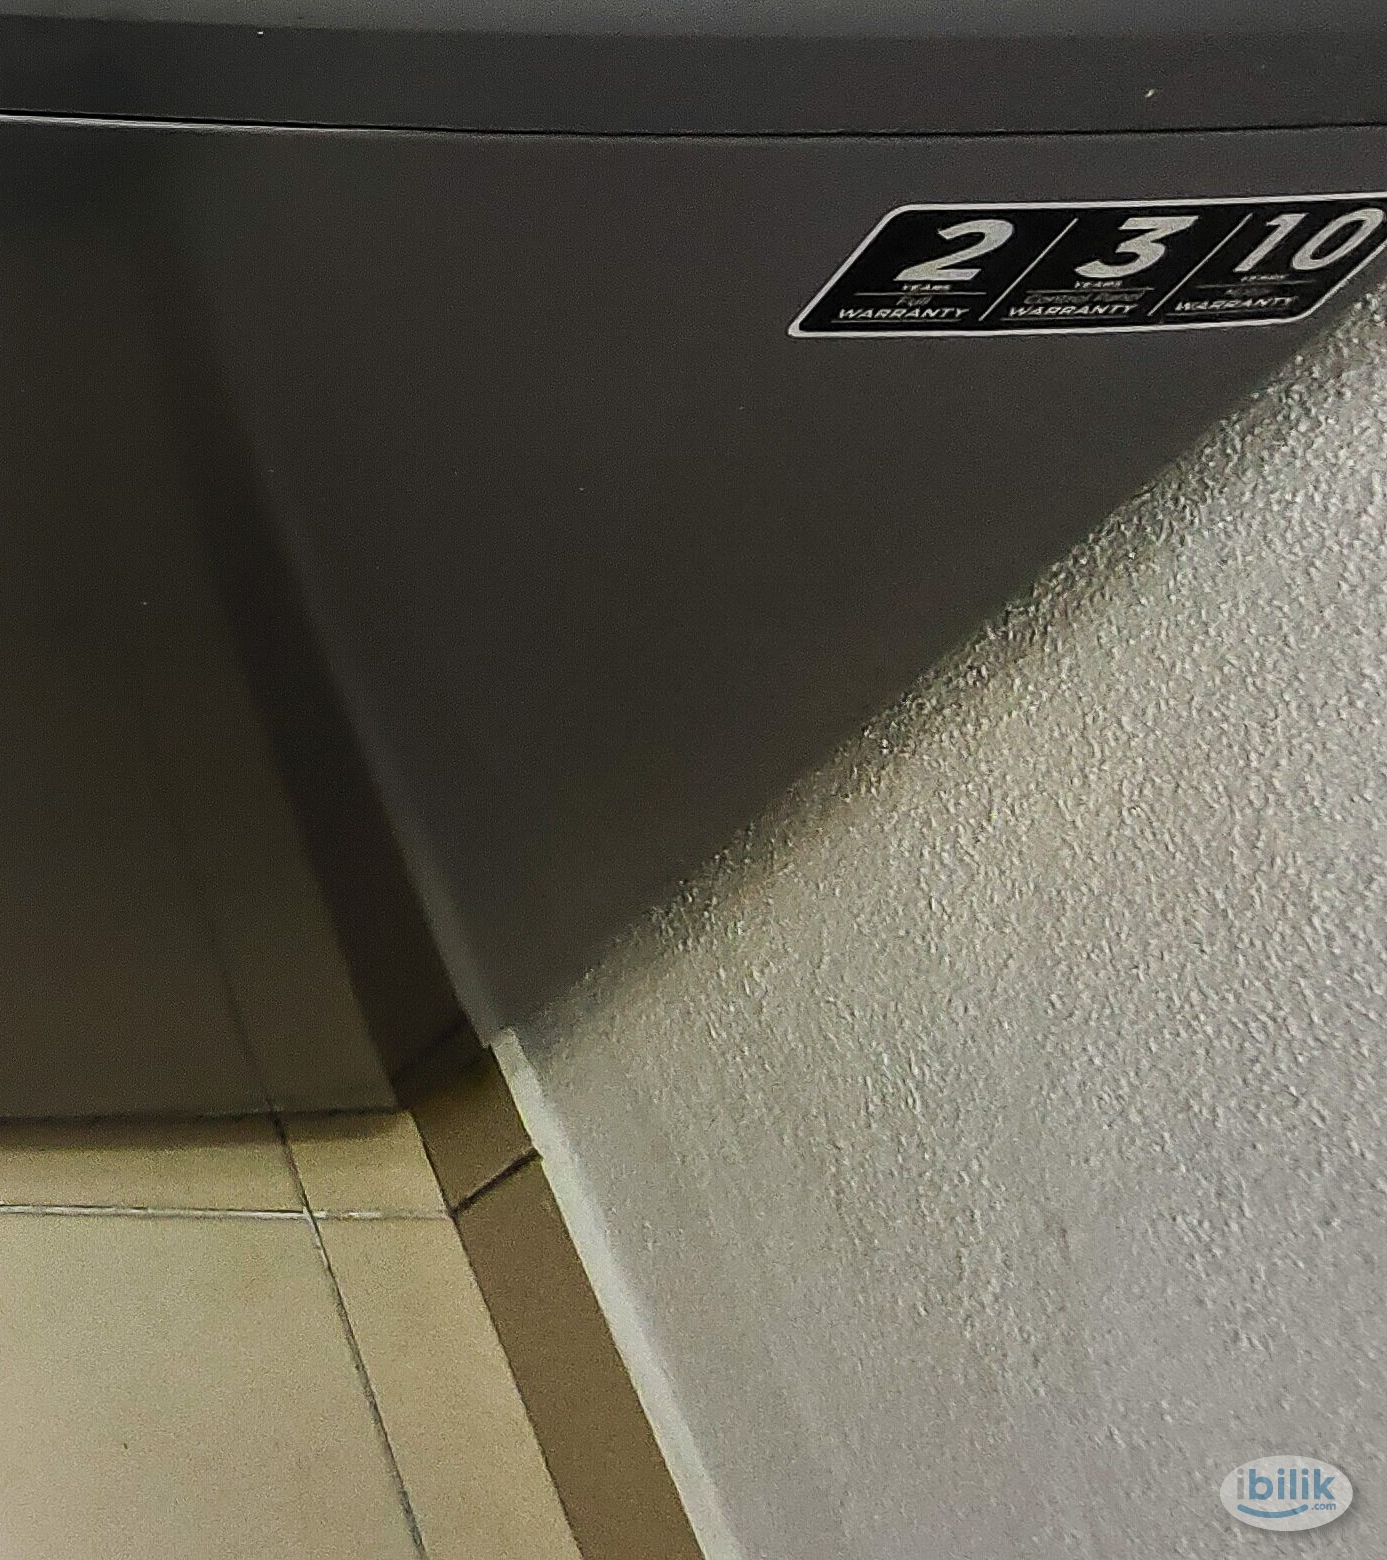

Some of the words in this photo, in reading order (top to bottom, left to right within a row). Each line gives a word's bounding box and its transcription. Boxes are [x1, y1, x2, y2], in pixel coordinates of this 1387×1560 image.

[893, 219, 1015, 282] 2
[1075, 215, 1199, 278] 3
[1232, 207, 1387, 272] 10
[839, 307, 970, 319] WARRANTY
[1009, 303, 1139, 317] WARRANTY
